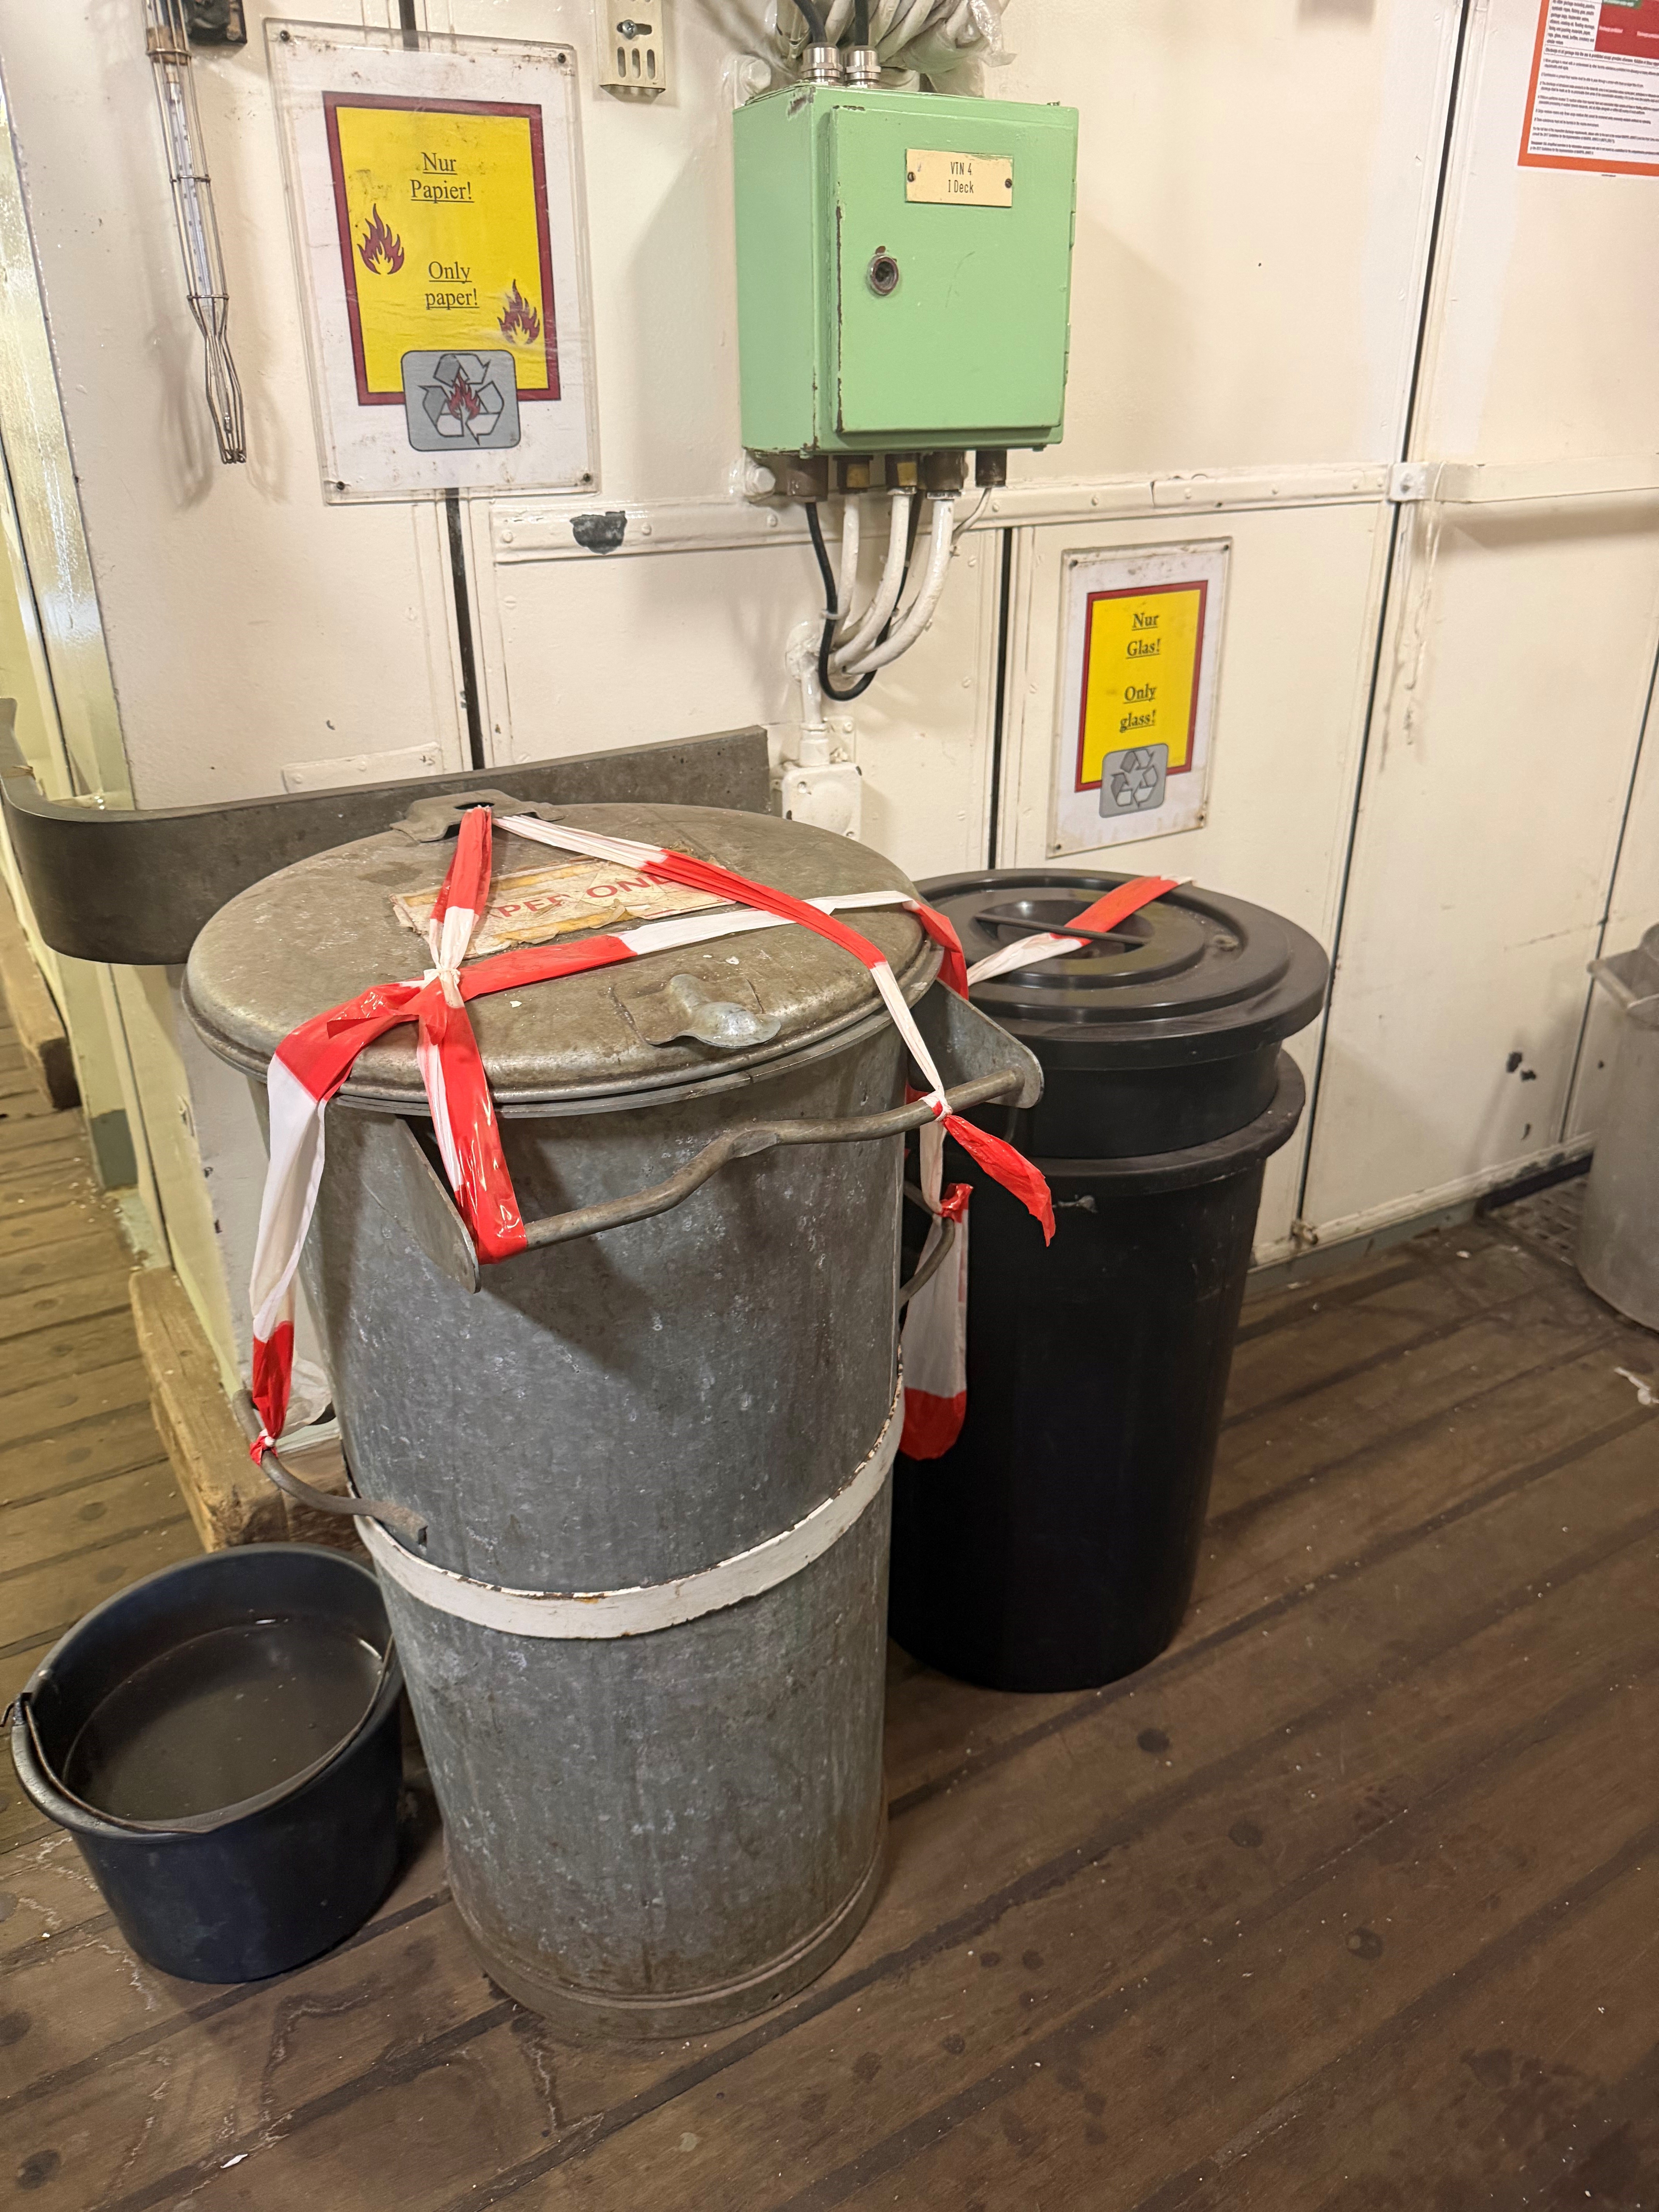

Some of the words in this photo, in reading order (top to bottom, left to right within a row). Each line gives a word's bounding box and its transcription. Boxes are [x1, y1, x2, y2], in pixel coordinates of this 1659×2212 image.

[422, 152, 457, 174] Nur
[967, 163, 972, 175] 4
[409, 179, 474, 203] Papier!
[954, 180, 974, 194] Deck
[428, 261, 472, 284] Only
[425, 288, 479, 310] paper!
[1132, 613, 1160, 630] Nur
[1126, 639, 1161, 659] Glas!
[1124, 684, 1157, 703] Only
[1119, 710, 1157, 733] glass!
[586, 874, 671, 898] ONL
